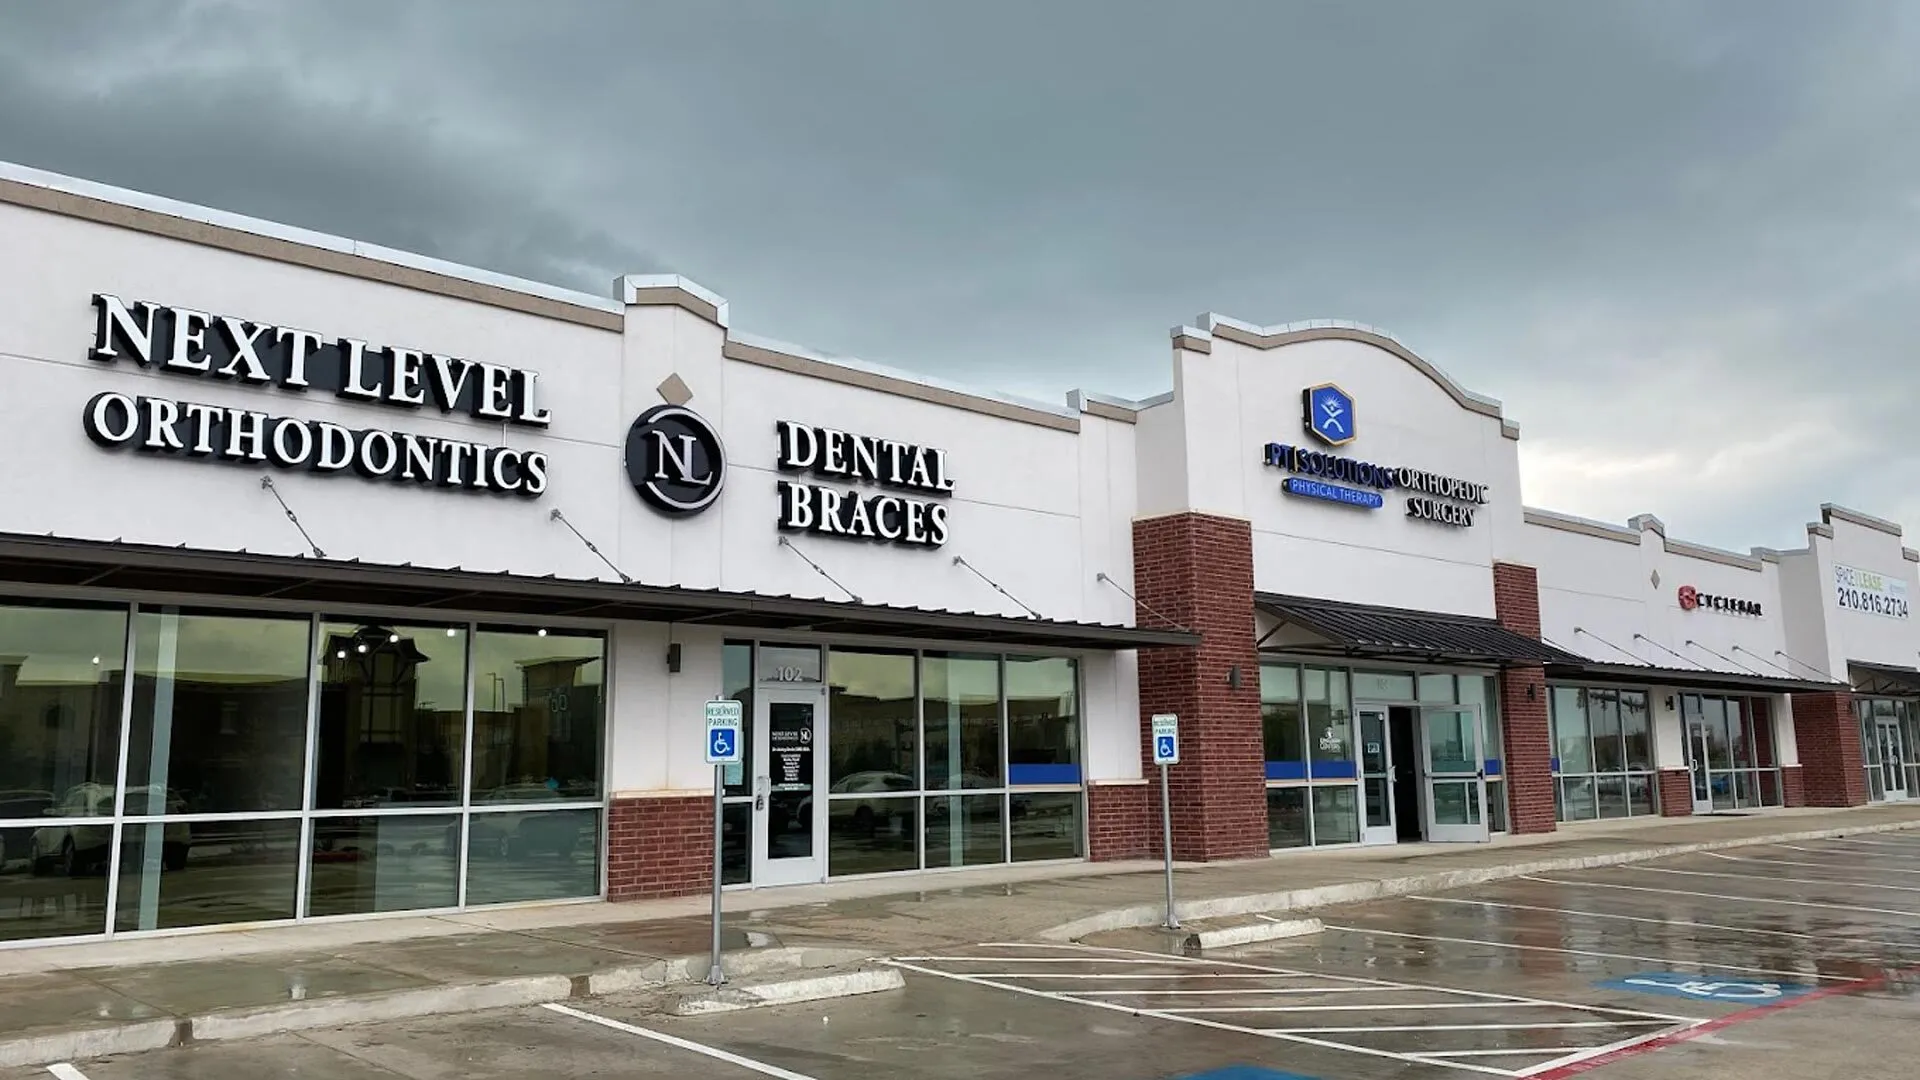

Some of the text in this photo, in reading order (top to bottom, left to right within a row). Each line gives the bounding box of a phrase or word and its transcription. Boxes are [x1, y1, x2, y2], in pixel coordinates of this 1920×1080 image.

[92, 293, 550, 425] NEXT LEVEL
[88, 391, 548, 495] ORTHODONTICS
[652, 430, 712, 485] NL
[782, 421, 955, 492] DENTAL
[1299, 449, 1396, 489] SOLUTIONS
[1399, 467, 1489, 503] ORTHOPEDIC
[1292, 479, 1380, 504] PHYSICAL THERAPY
[782, 482, 949, 546] BRACES
[1411, 497, 1474, 526] SURGERY
[1696, 593, 1763, 616] CYCLEBAR
[1837, 586, 1909, 619] 210.816.2734
[777, 666, 803, 682] 102
[708, 717, 738, 727] PARKING
